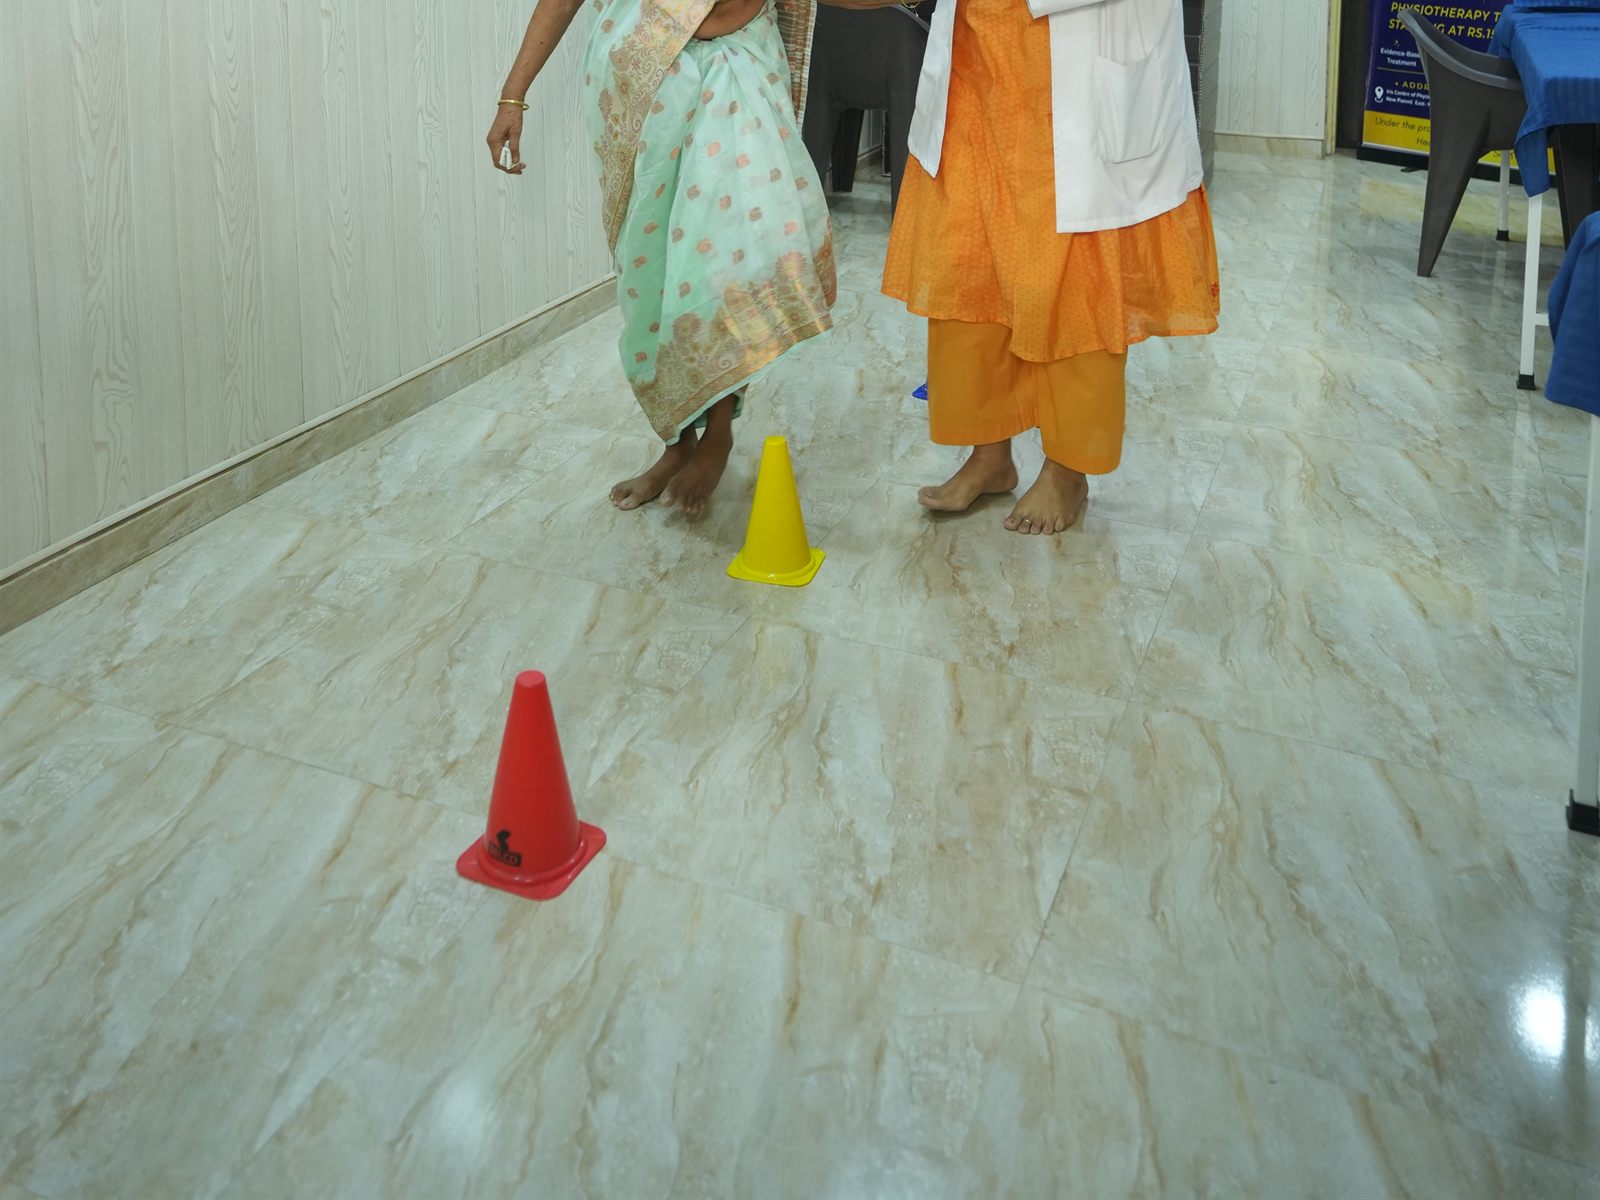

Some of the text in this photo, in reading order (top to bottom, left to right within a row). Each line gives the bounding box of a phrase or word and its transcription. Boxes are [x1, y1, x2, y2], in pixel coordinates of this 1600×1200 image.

[1447, 25, 1464, 36] AT
[1387, 57, 1417, 67] Treatment
[1375, 117, 1415, 130] Under the
